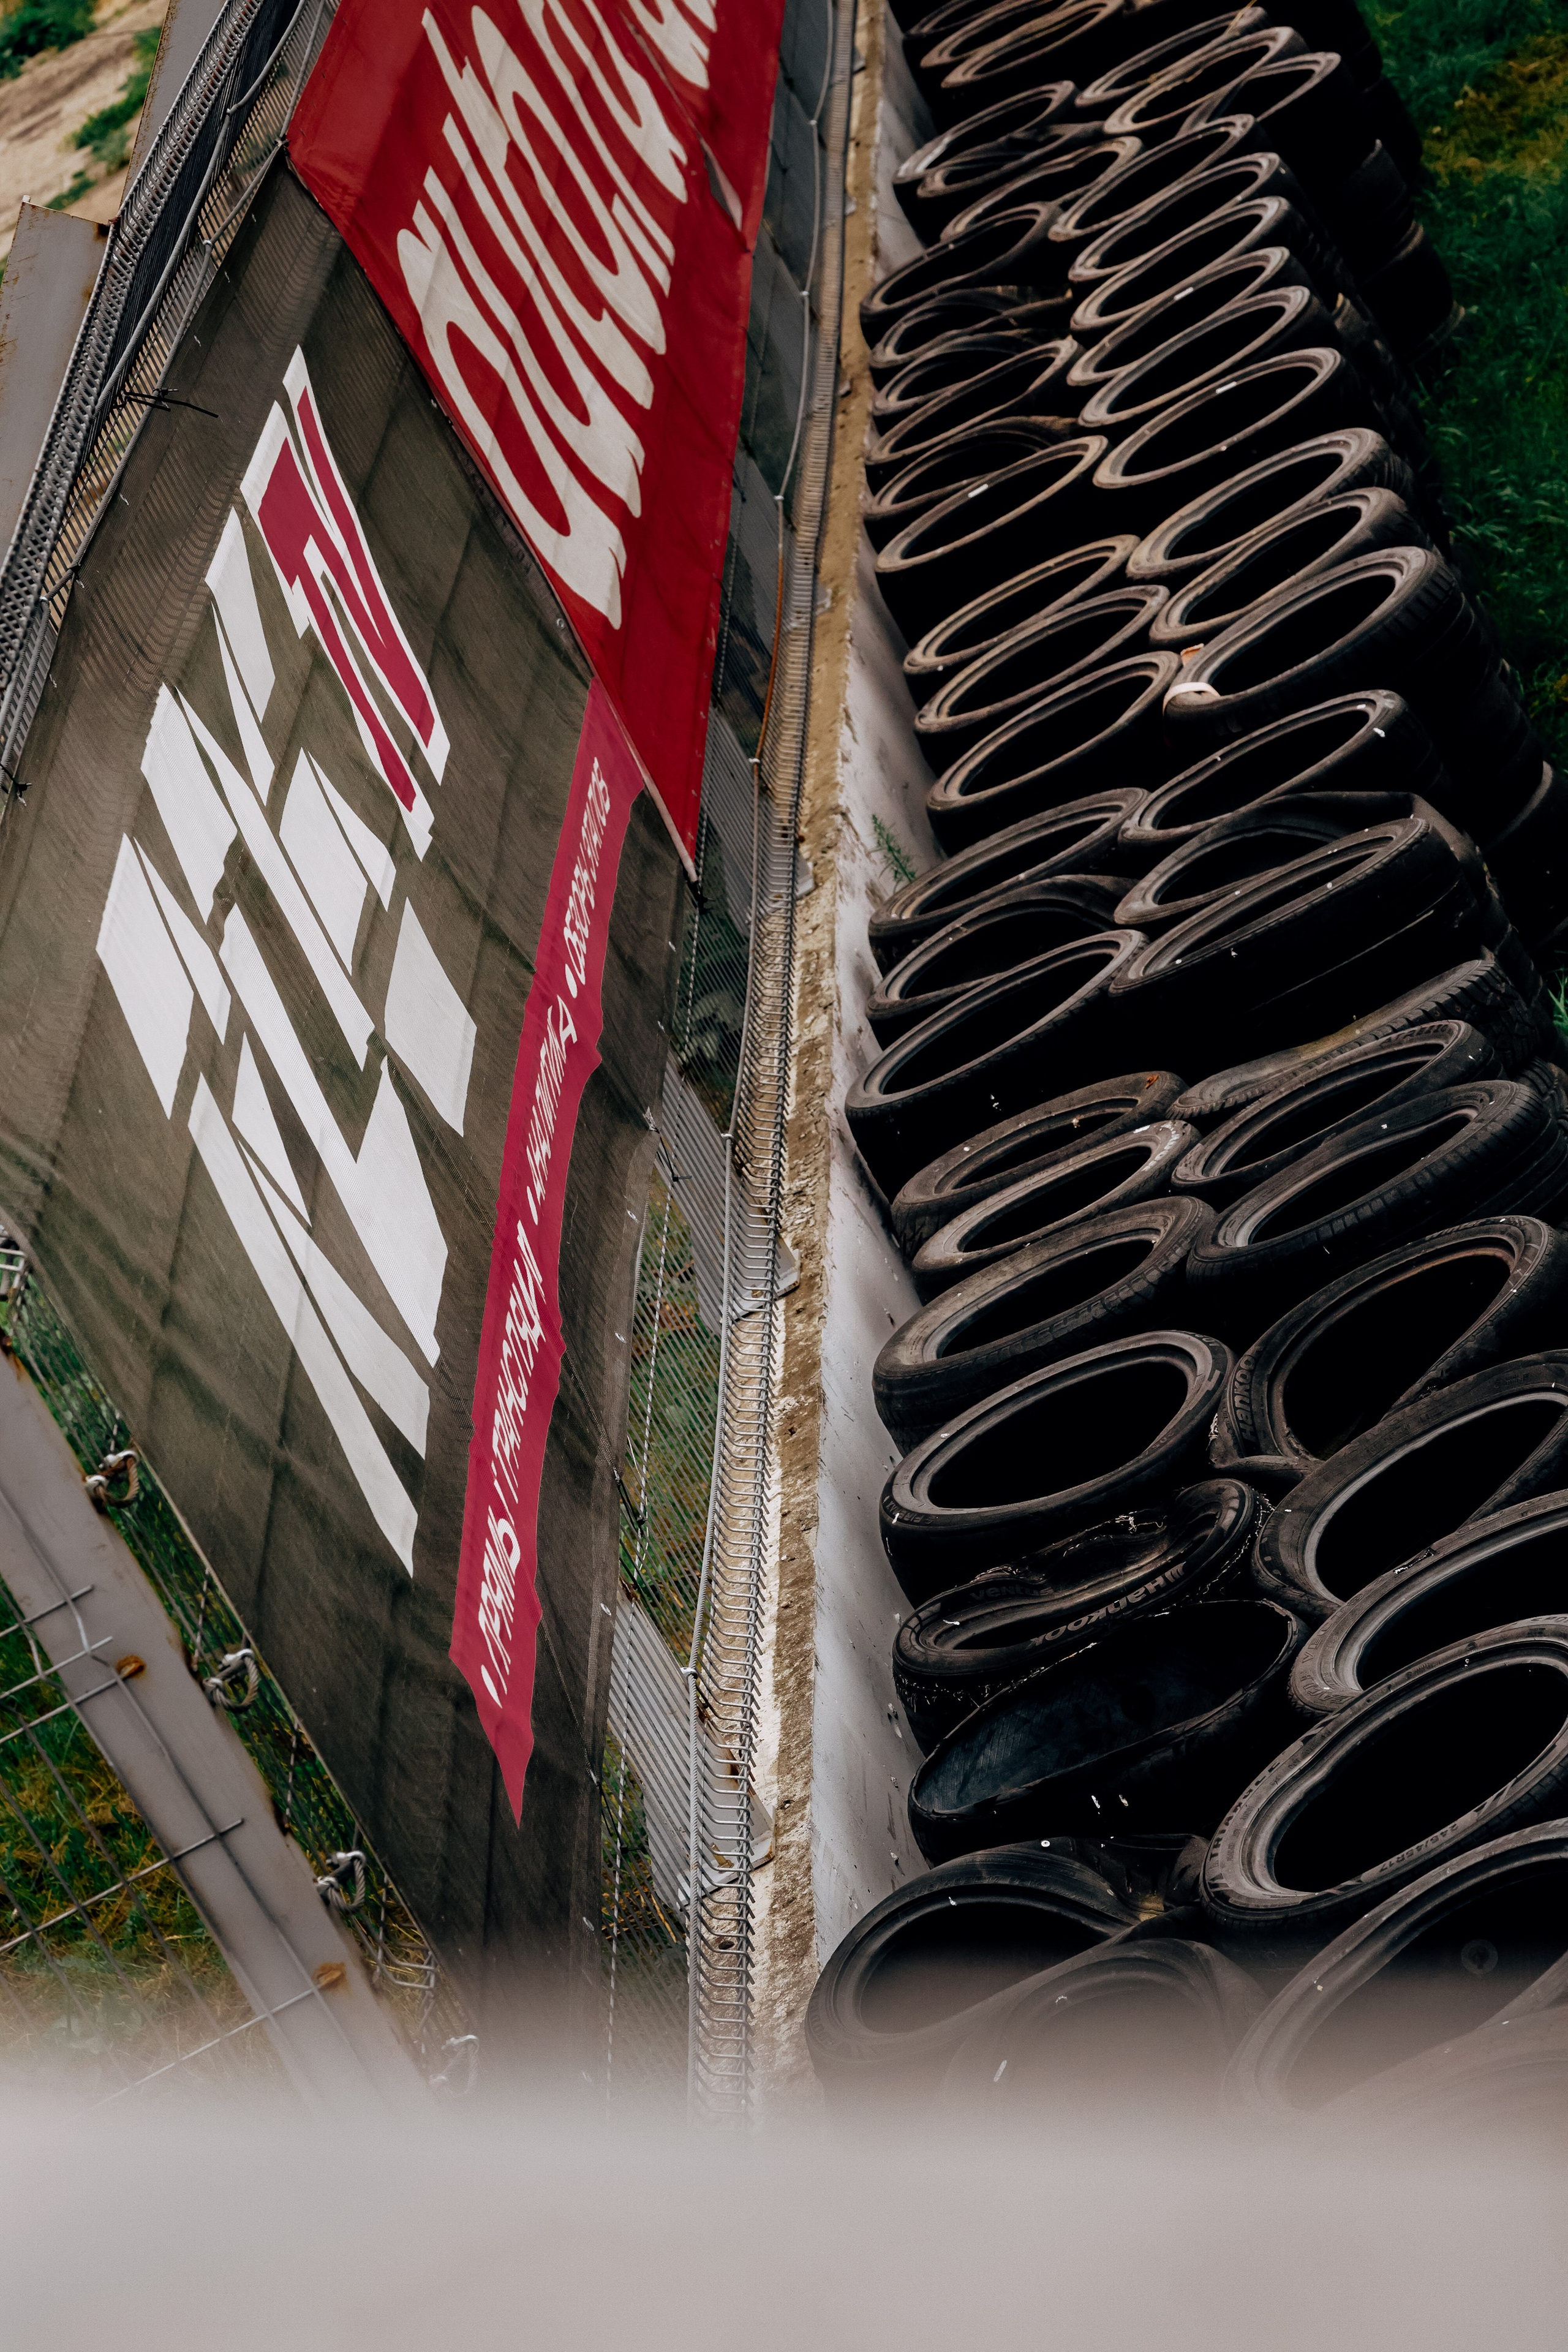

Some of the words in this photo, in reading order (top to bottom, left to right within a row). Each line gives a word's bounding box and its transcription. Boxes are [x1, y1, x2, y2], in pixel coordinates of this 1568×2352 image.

[239, 346, 451, 863] TV
[478, 1461, 521, 1695] ПРЯМЫ
[527, 994, 578, 1206] АНАЛИТИКА
[564, 842, 595, 986] ОБЗОРЫ
[581, 756, 611, 883] ЭТАПОВ
[1233, 1349, 1261, 1442] Hankoo
[1023, 1574, 1169, 1650] Hankook
[1208, 1762, 1281, 1856] TRIANGLE
